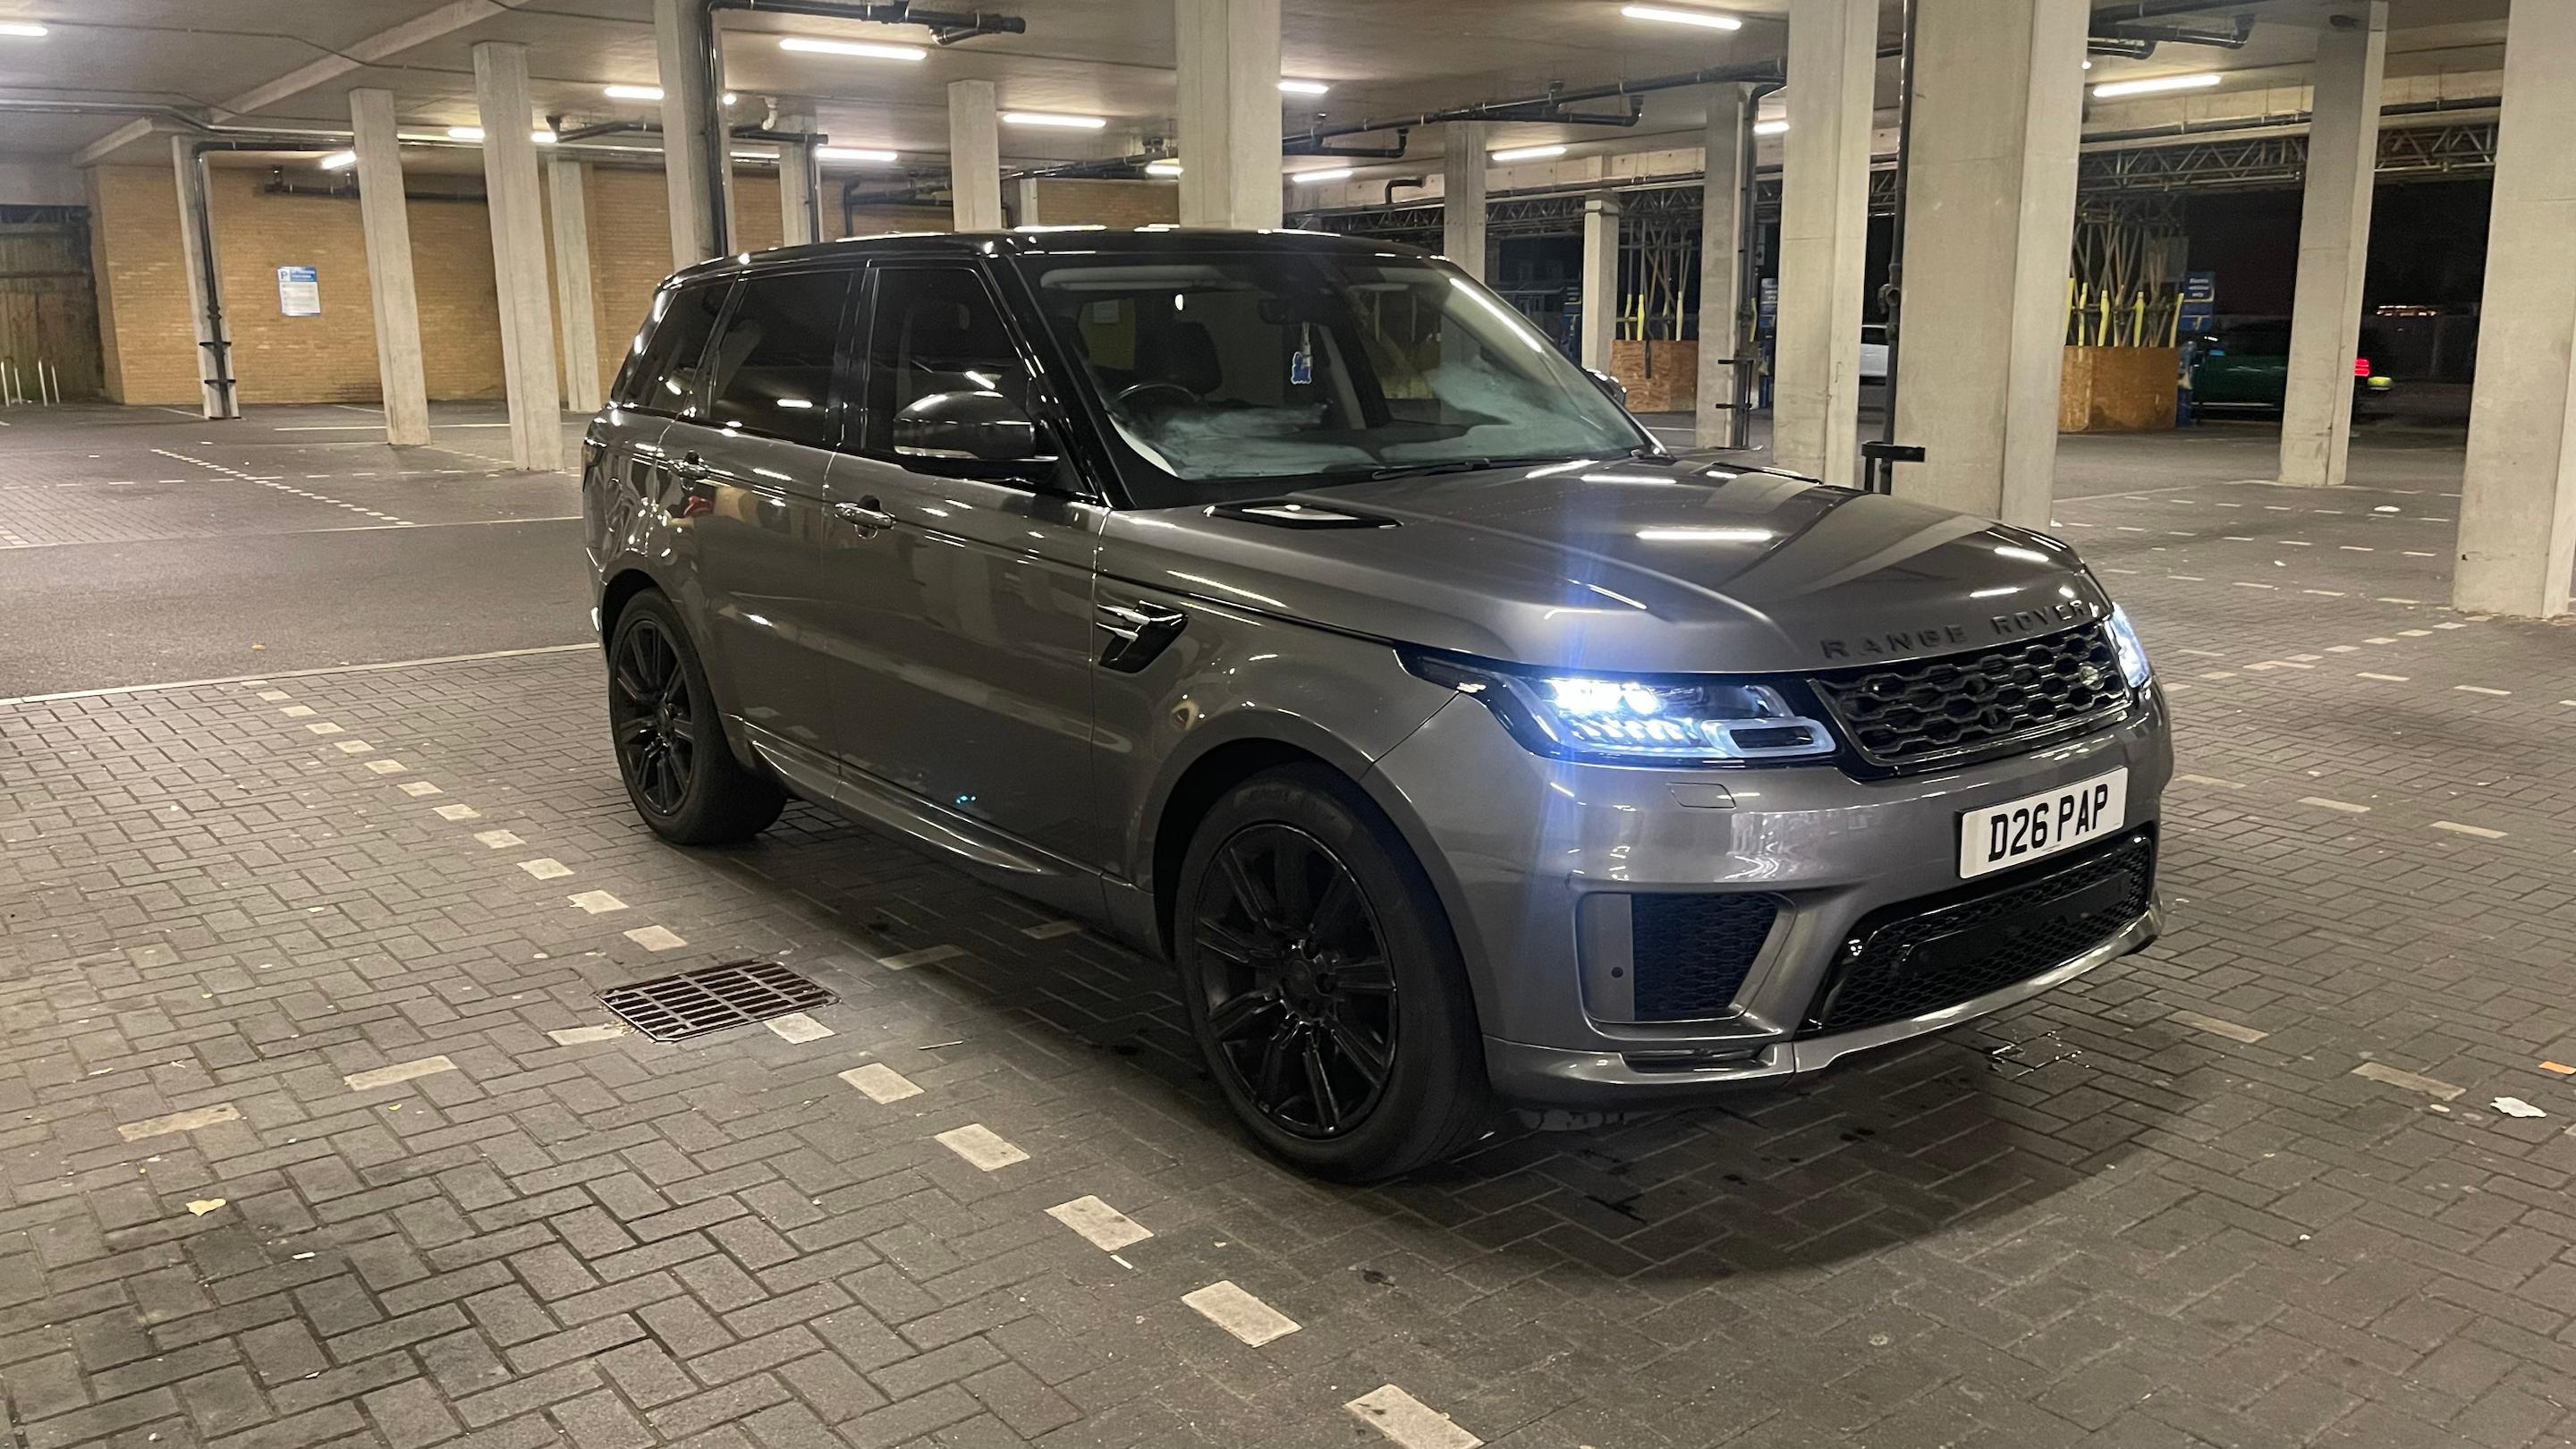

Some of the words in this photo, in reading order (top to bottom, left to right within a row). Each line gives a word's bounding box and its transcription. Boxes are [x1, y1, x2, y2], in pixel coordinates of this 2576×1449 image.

[1820, 625, 1966, 659] RANGE
[1989, 599, 2086, 634] ROVER
[1987, 802, 2049, 862] D26
[2057, 784, 2108, 843] PAP
